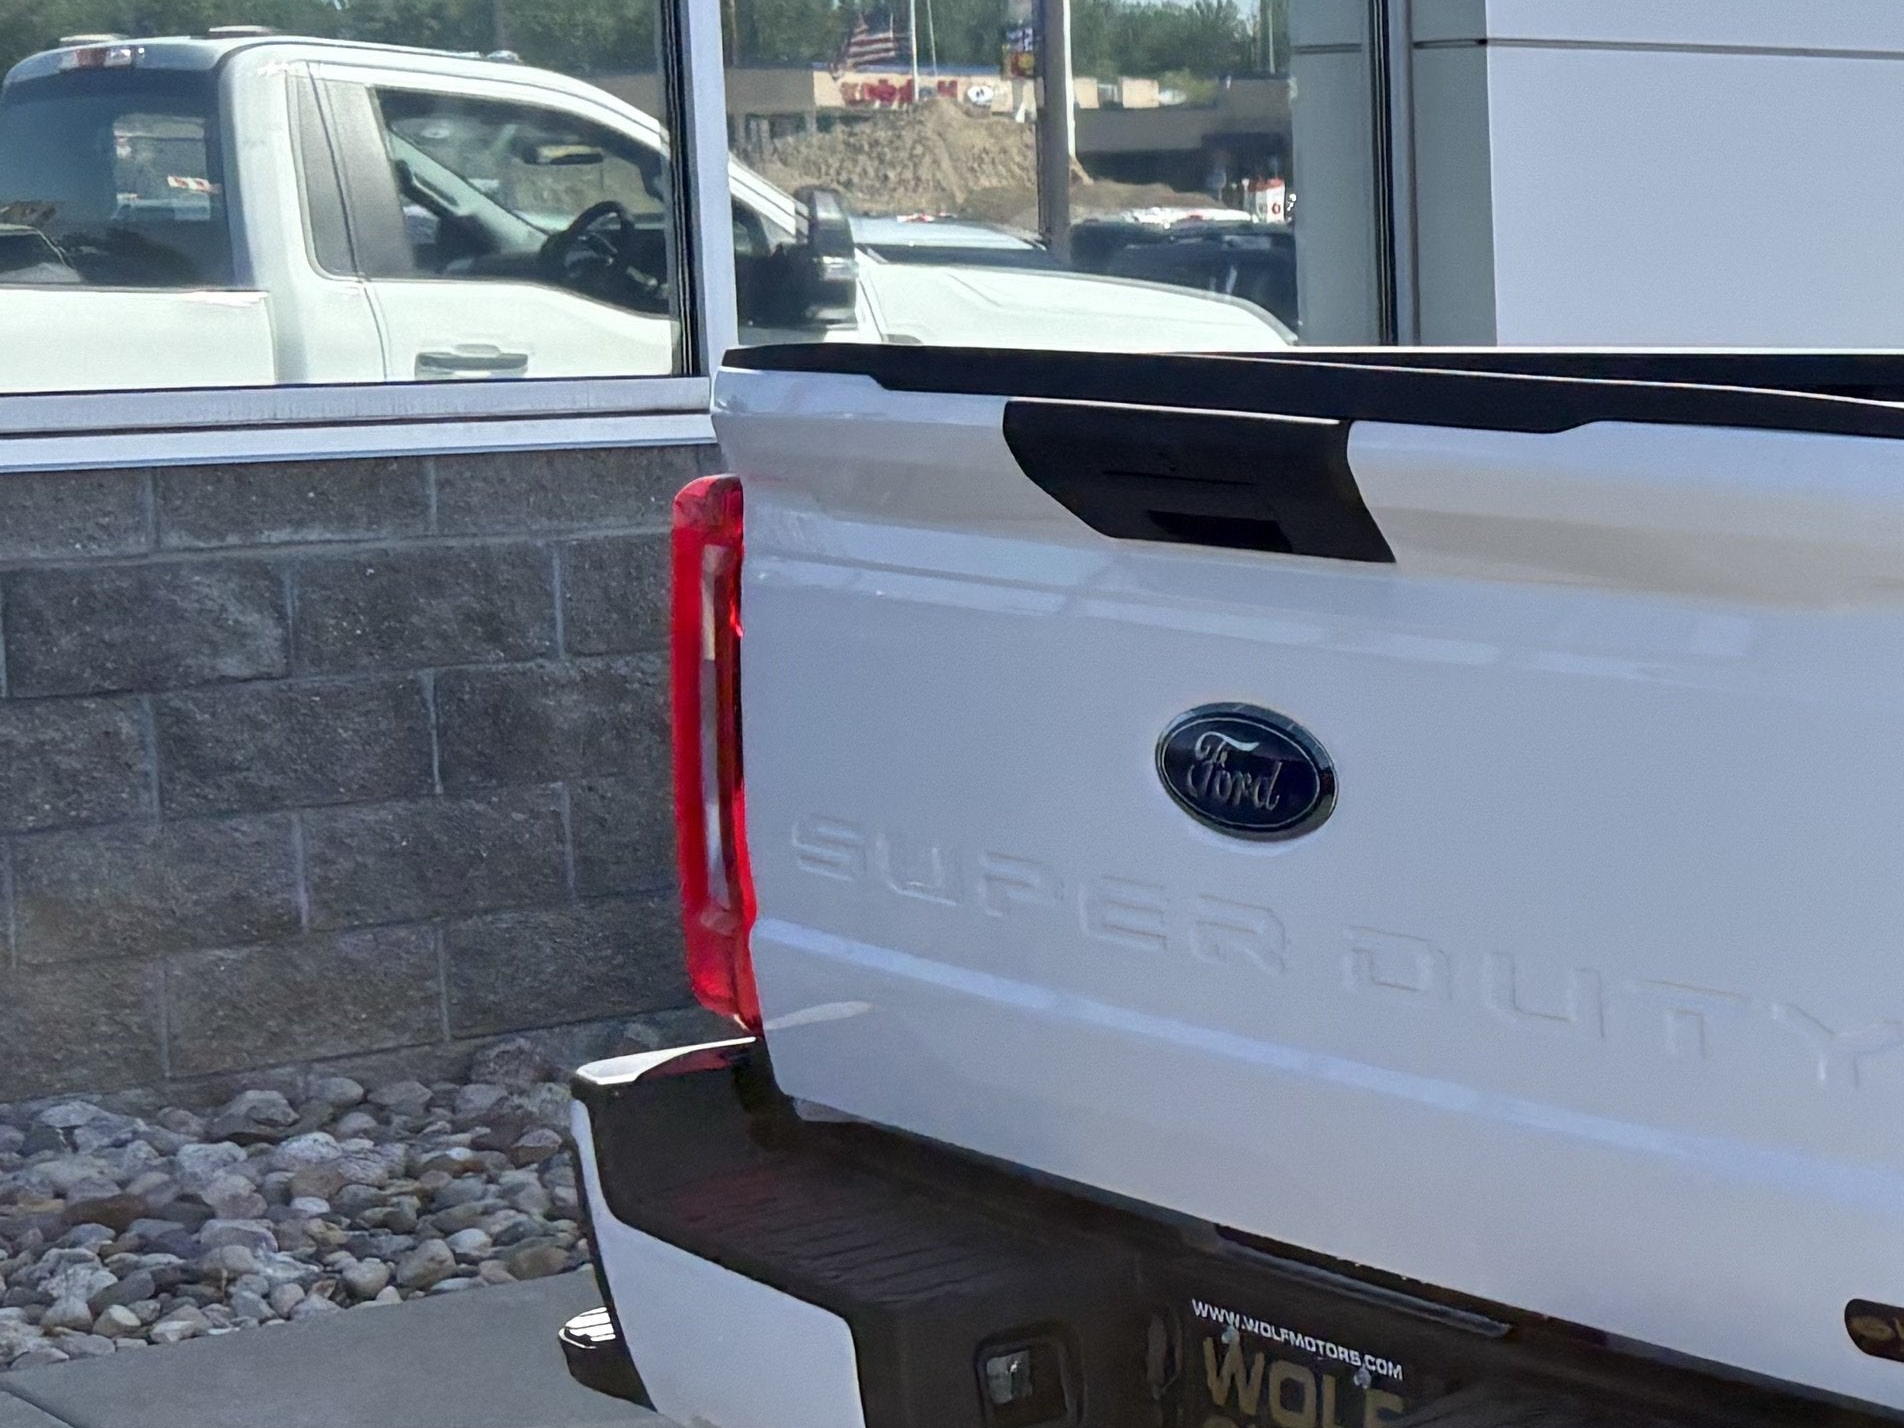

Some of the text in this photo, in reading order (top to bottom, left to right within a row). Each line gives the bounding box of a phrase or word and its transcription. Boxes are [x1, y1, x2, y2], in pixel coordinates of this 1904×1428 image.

[1187, 730, 1281, 811] Ford
[790, 813, 1291, 974] SUPER
[1192, 1298, 1403, 1381] WWW.WOLFMOTORS.COM
